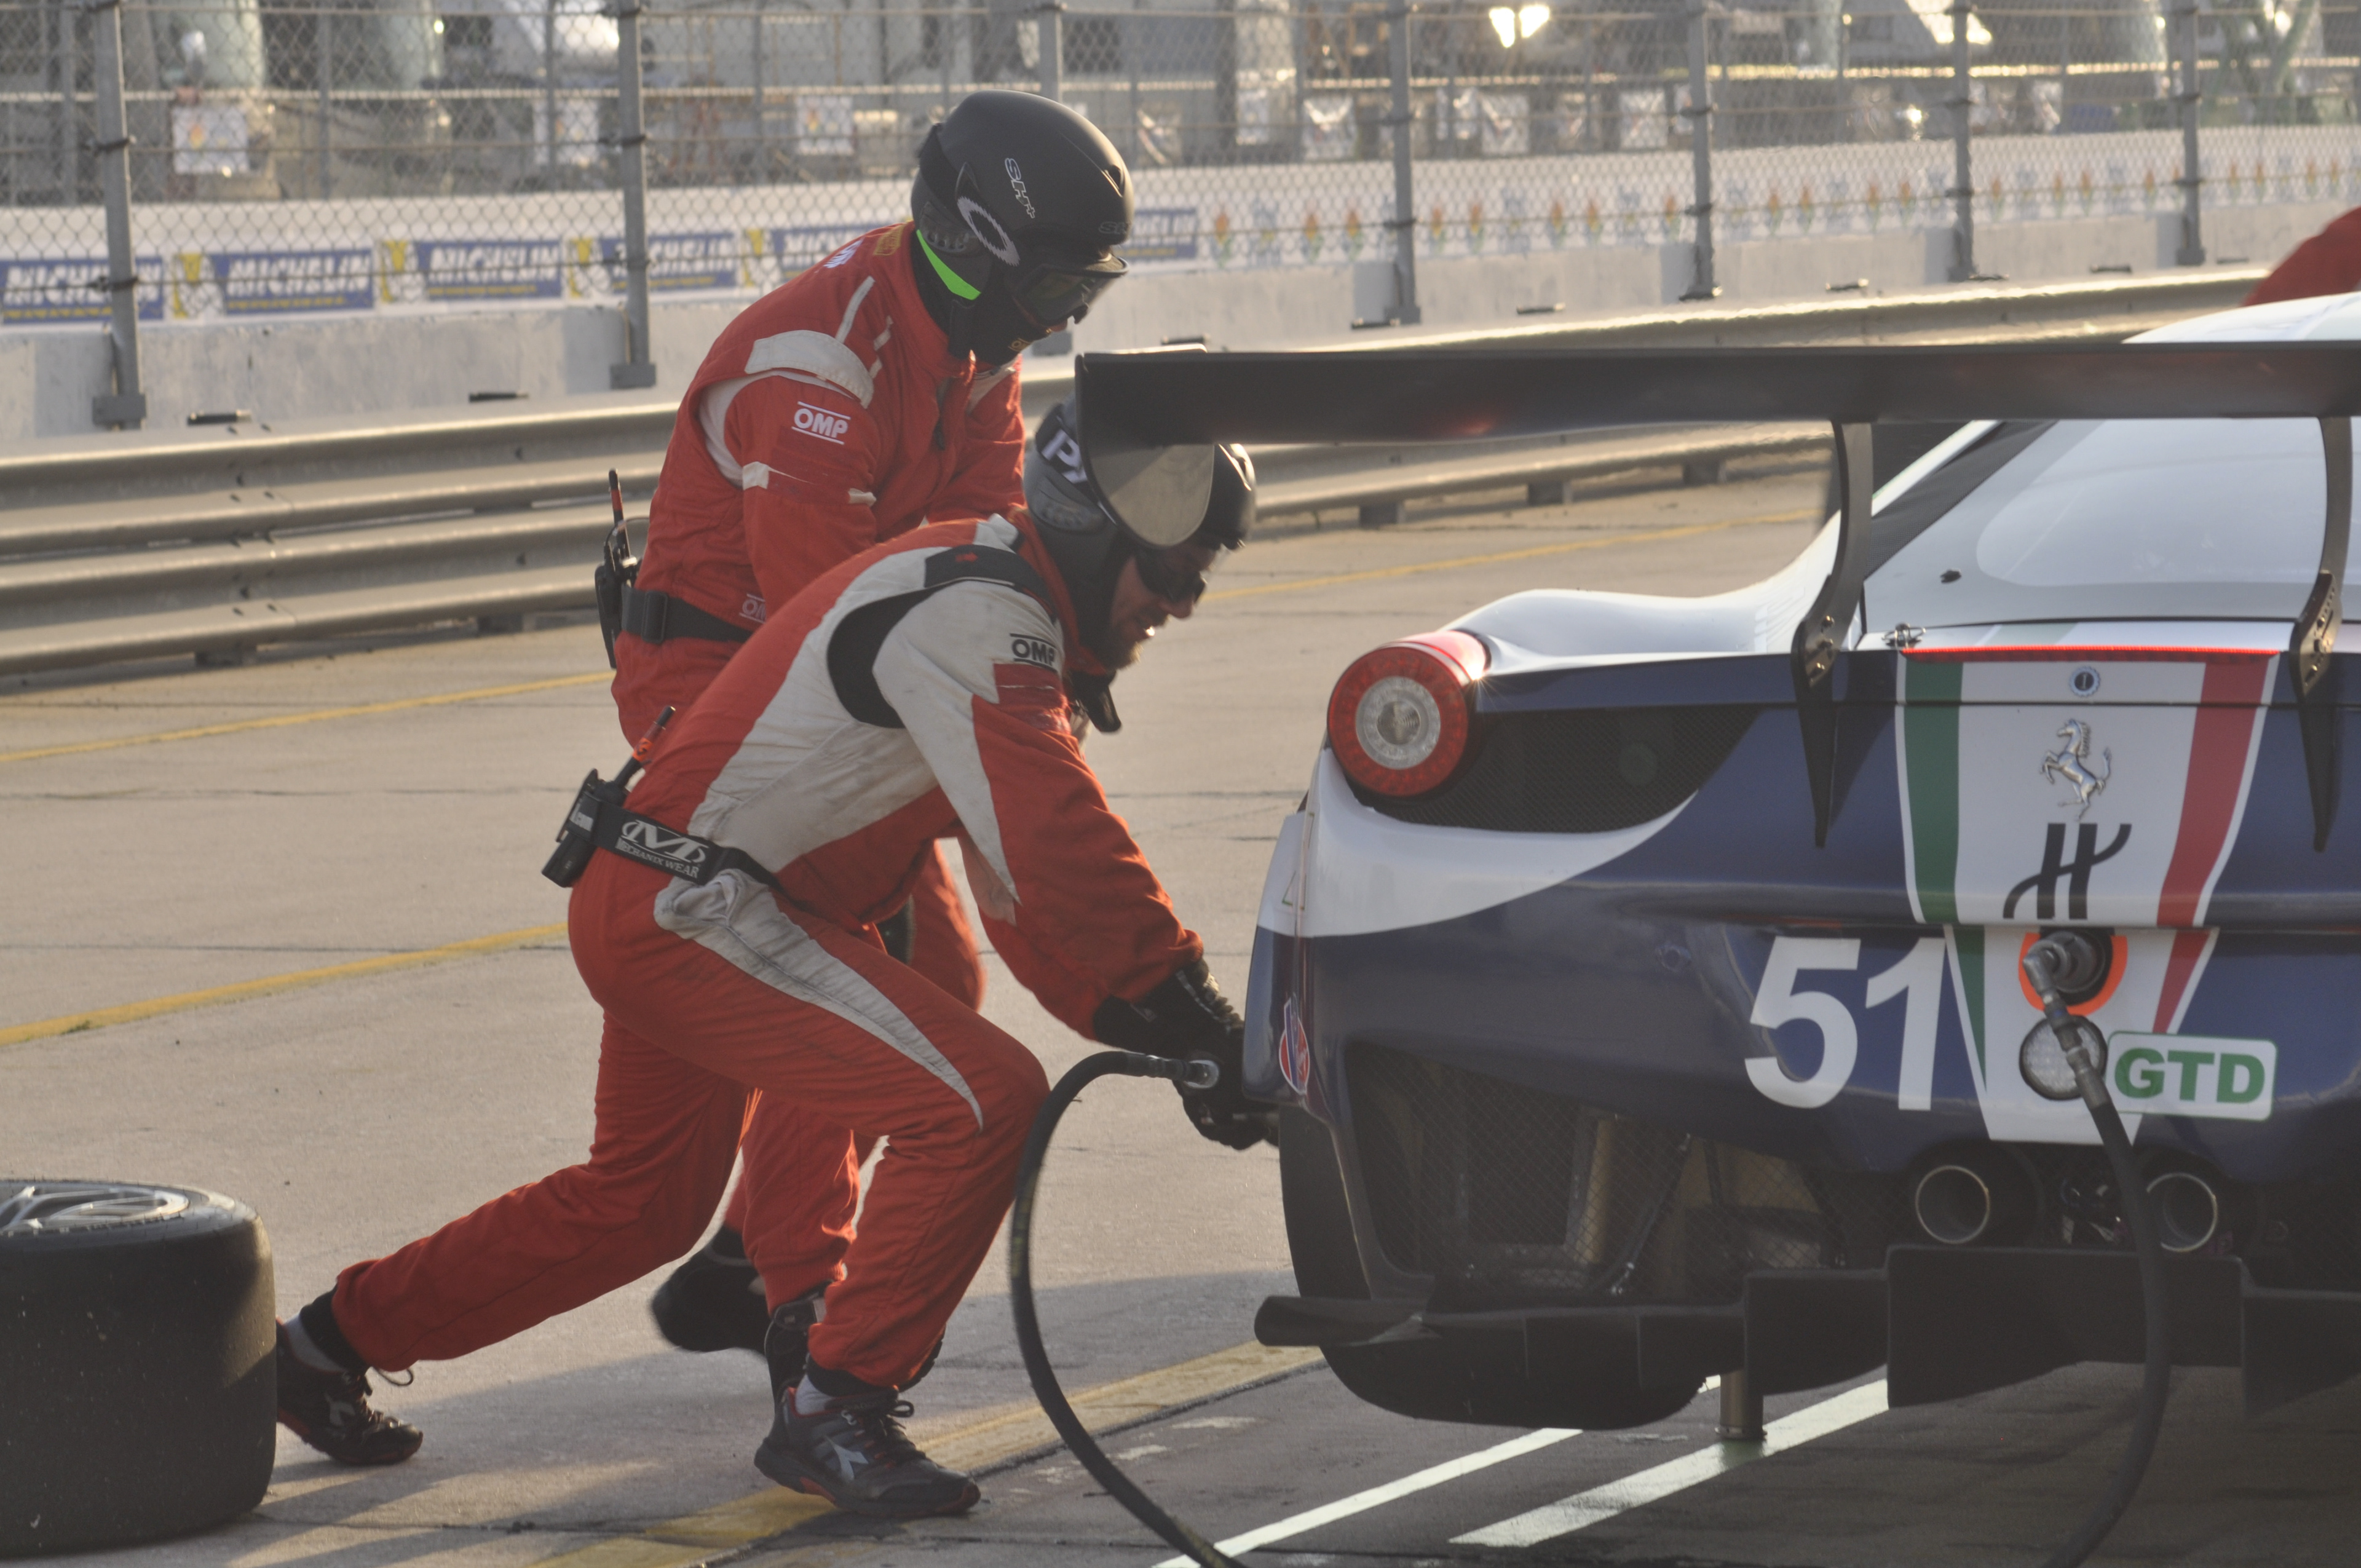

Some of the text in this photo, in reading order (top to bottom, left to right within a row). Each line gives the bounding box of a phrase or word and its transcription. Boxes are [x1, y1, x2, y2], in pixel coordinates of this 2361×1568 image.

[3, 263, 161, 306] MICHEN
[226, 255, 370, 297] MICHELIN
[794, 408, 848, 438] OMP
[1011, 639, 1055, 667] OMP
[615, 837, 700, 879] MECHANIX WEAR
[1744, 935, 1947, 1111] 51
[2114, 1047, 2266, 1104] GTD
